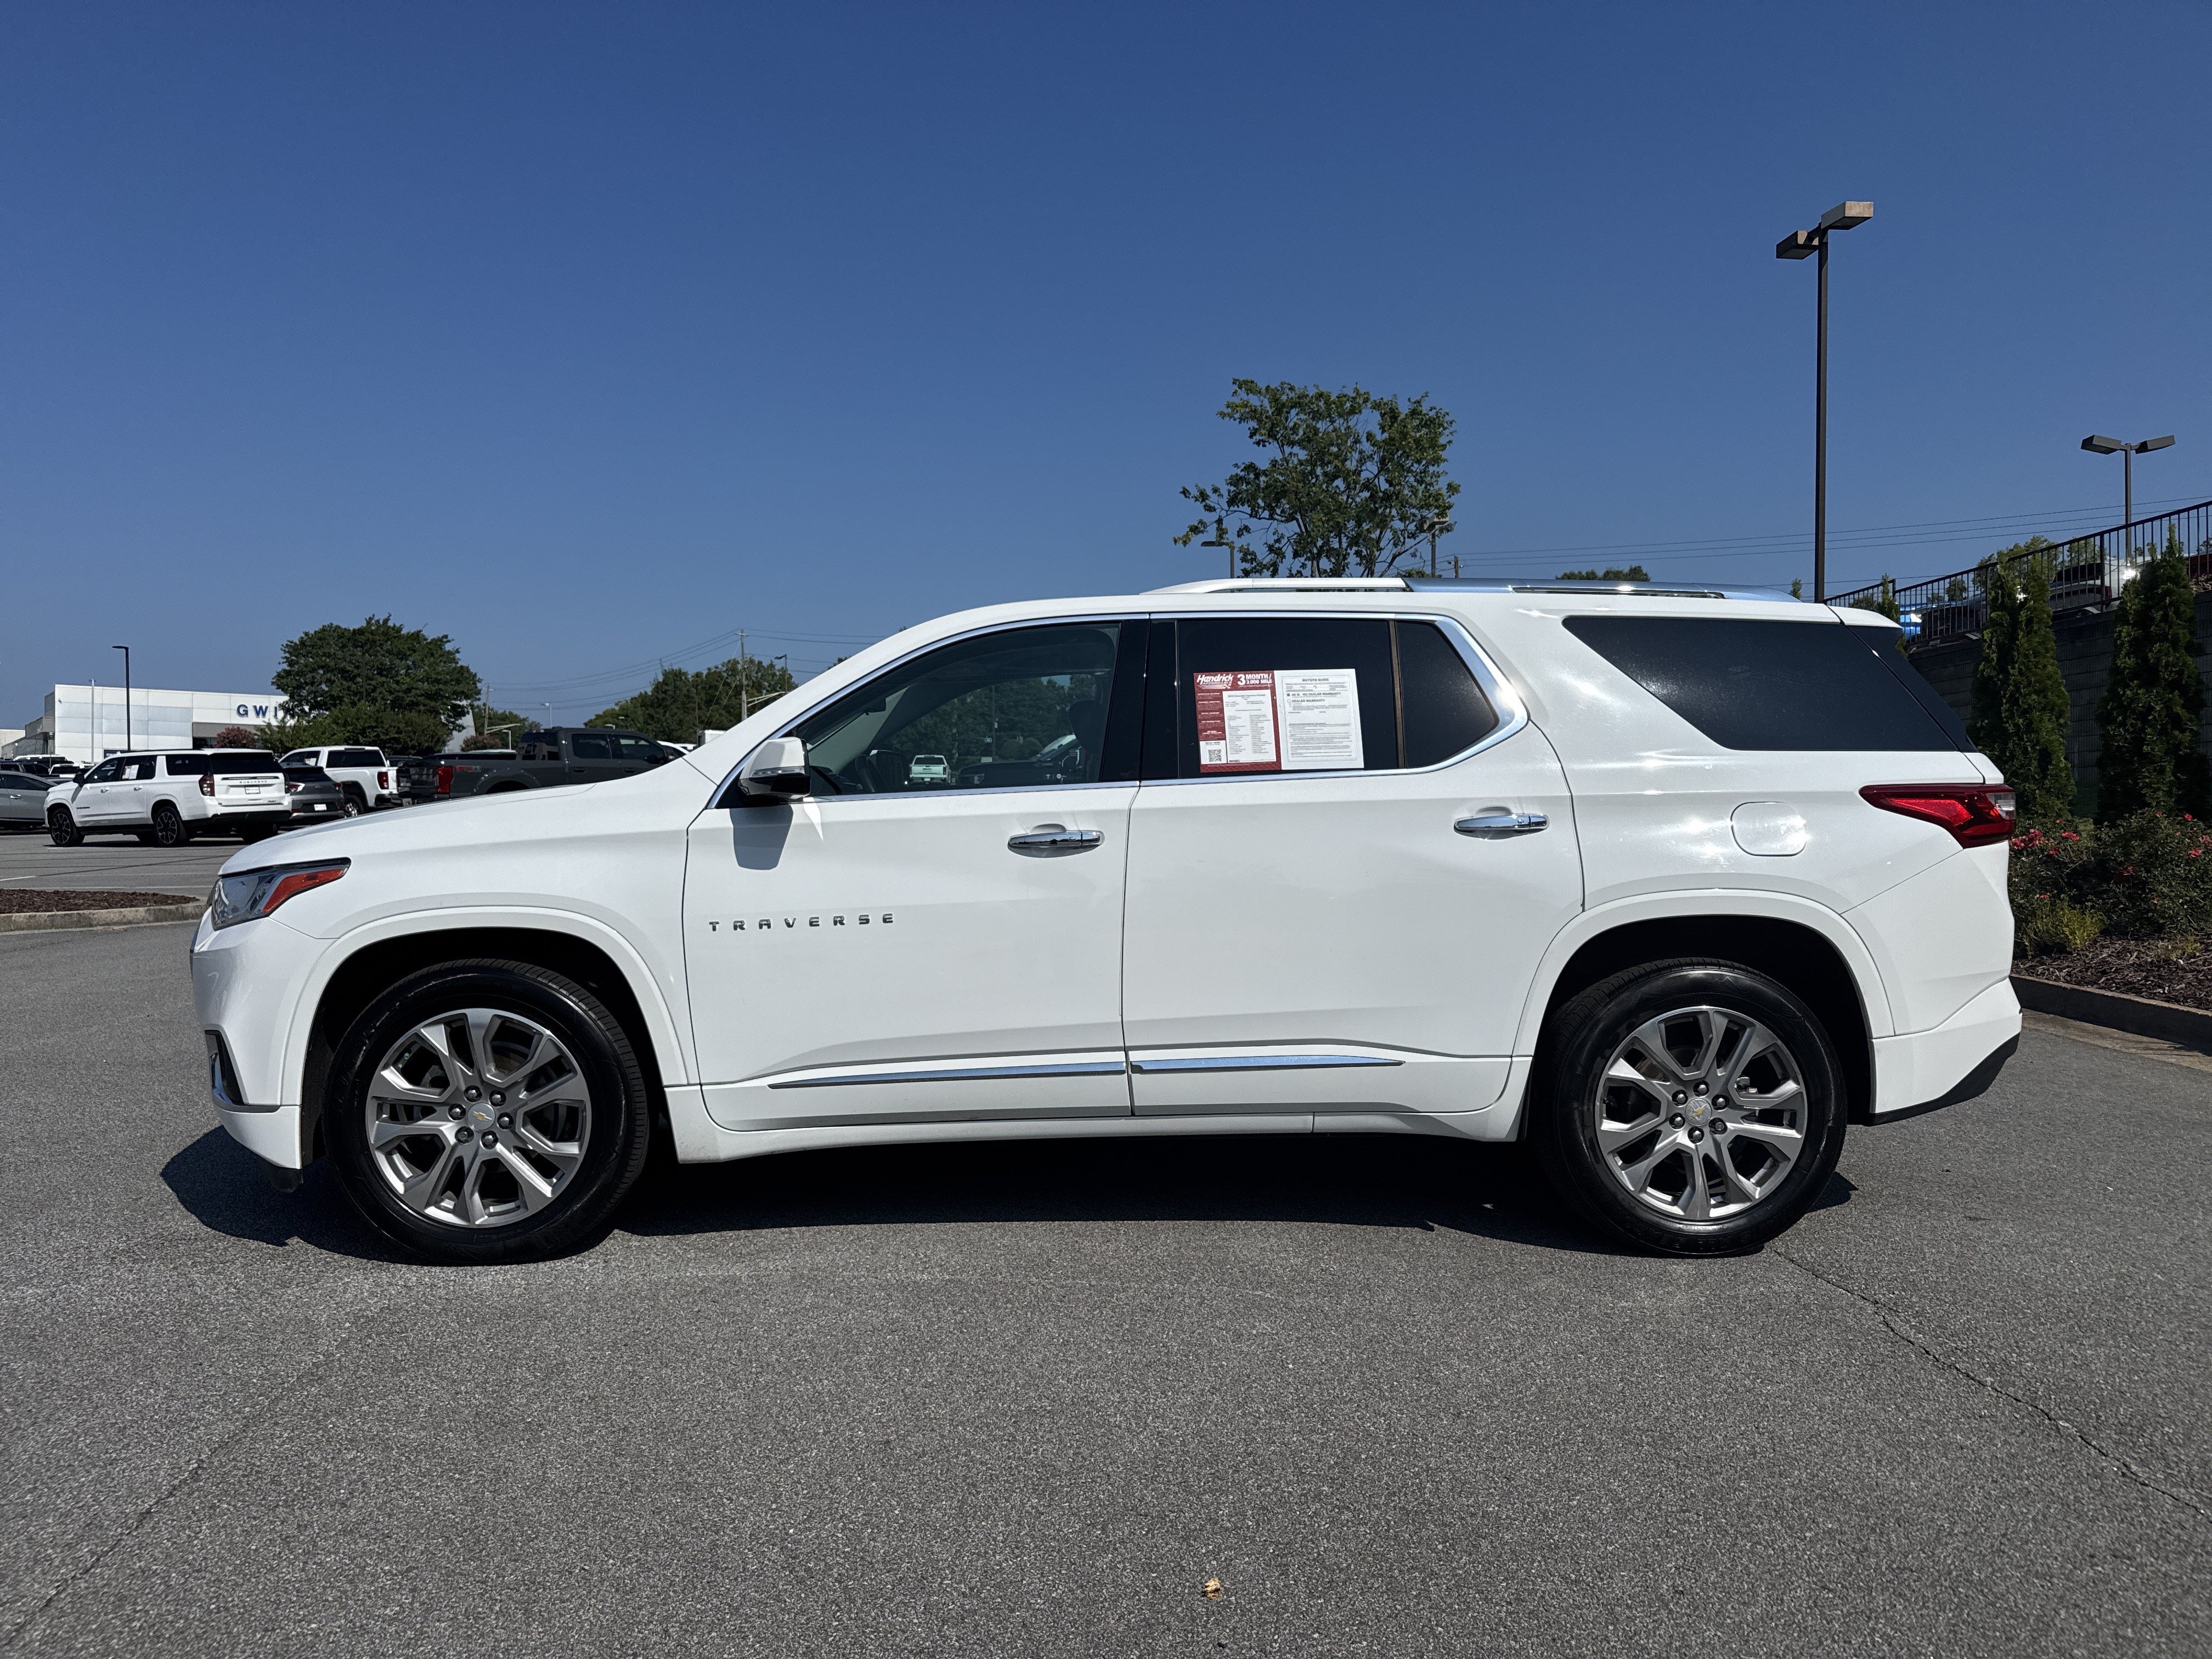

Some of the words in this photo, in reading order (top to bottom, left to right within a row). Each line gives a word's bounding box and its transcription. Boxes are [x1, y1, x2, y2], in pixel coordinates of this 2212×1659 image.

[1197, 674, 1234, 685] Hendrick
[1237, 674, 1246, 685] 3
[709, 913, 894, 932] TRAVERSE
